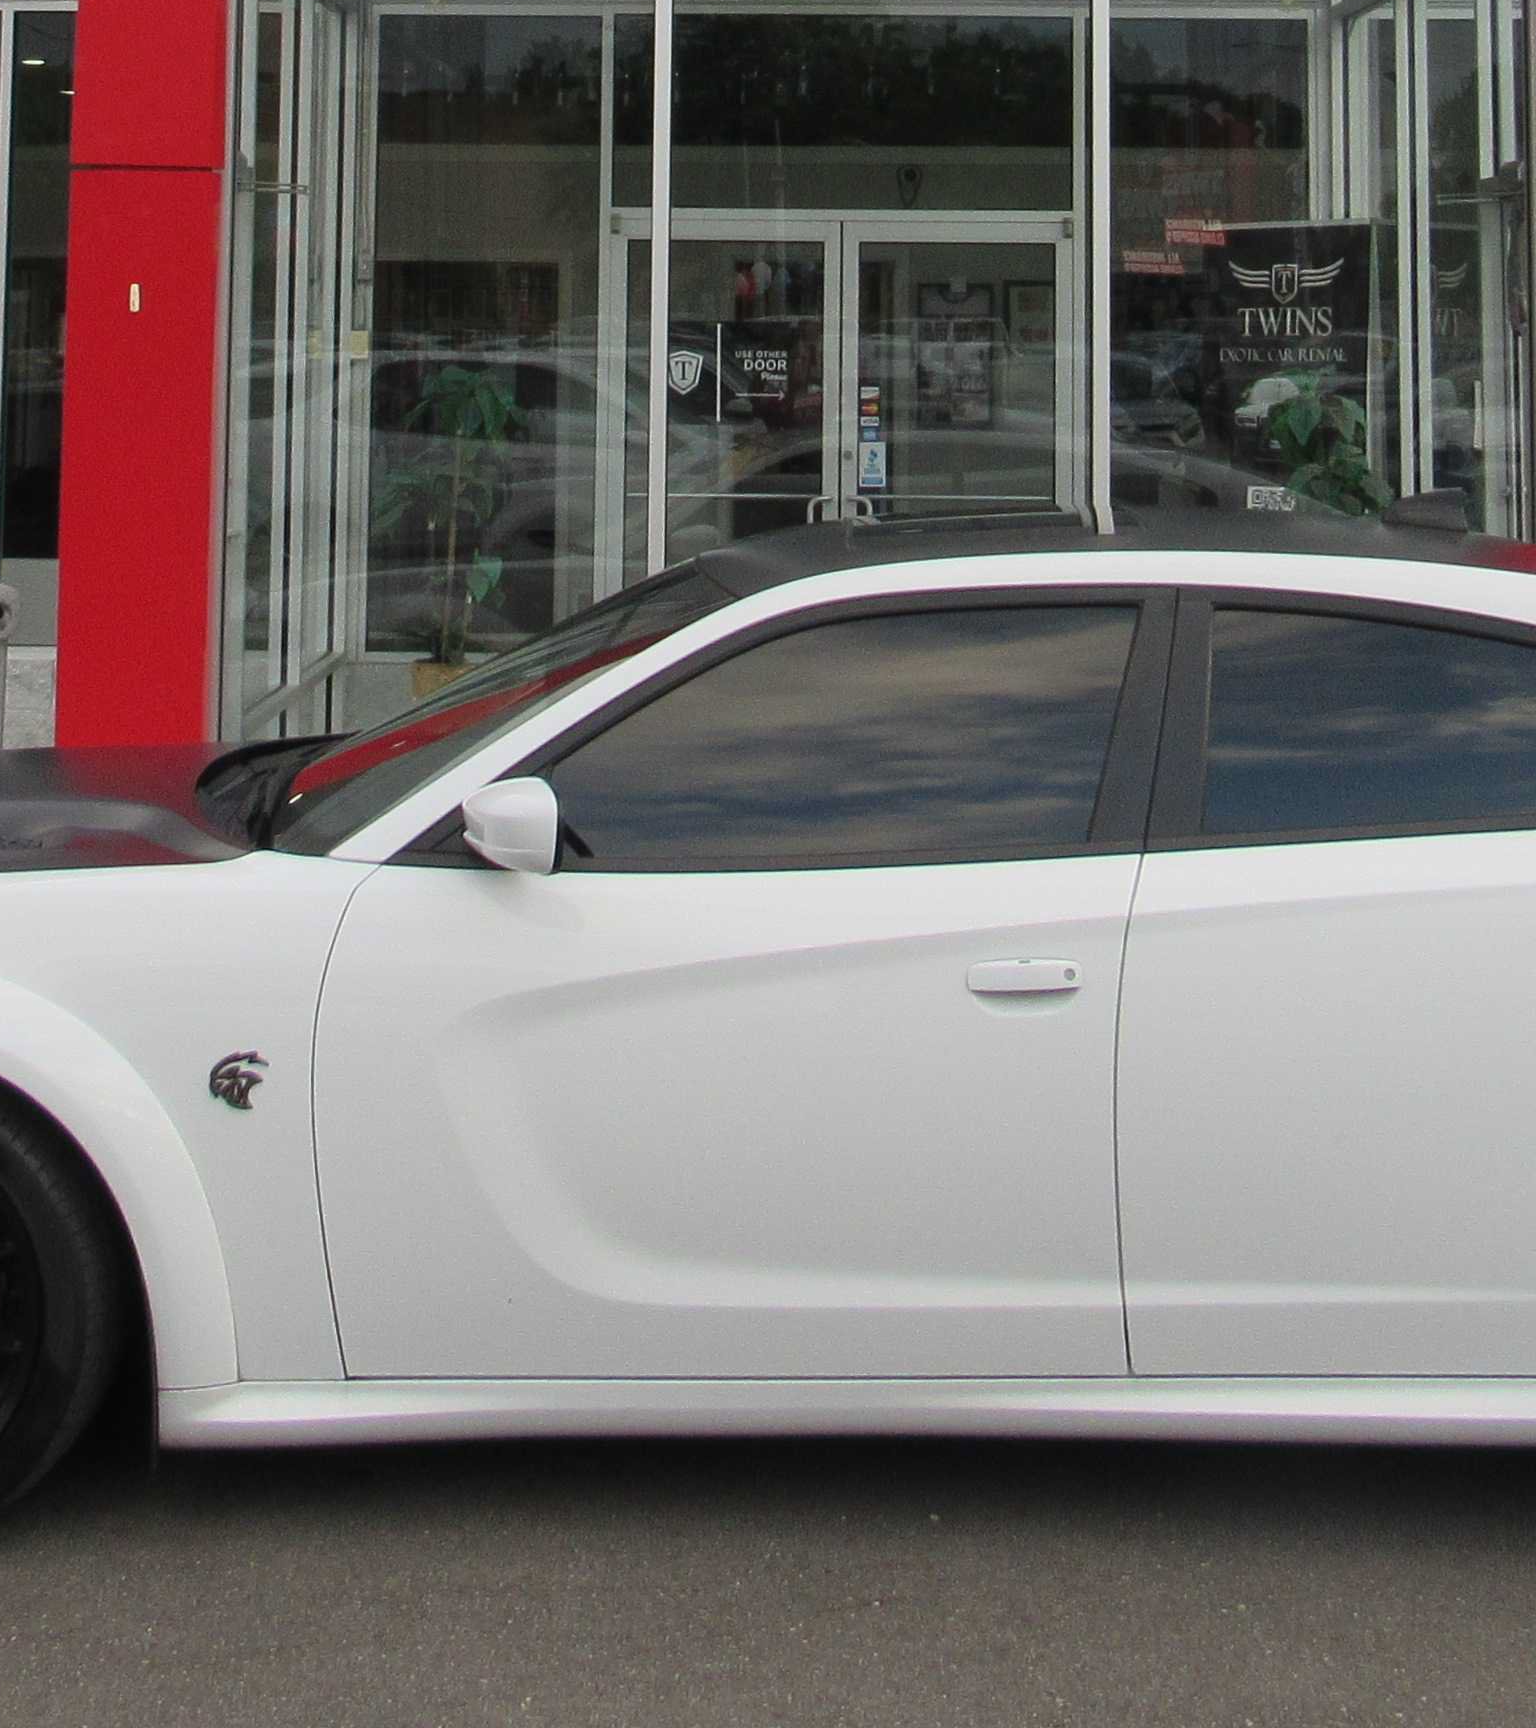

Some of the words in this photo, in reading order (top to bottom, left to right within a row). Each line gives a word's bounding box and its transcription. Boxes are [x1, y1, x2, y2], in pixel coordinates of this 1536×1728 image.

[1236, 306, 1333, 337] TWINS
[735, 350, 752, 359] USE
[755, 350, 788, 359] OTHER
[1219, 347, 1264, 362] EXOTIC
[1266, 347, 1295, 362] CAR
[1298, 347, 1347, 362] RENTAL
[674, 359, 693, 381] T
[744, 359, 788, 371] DOOR
